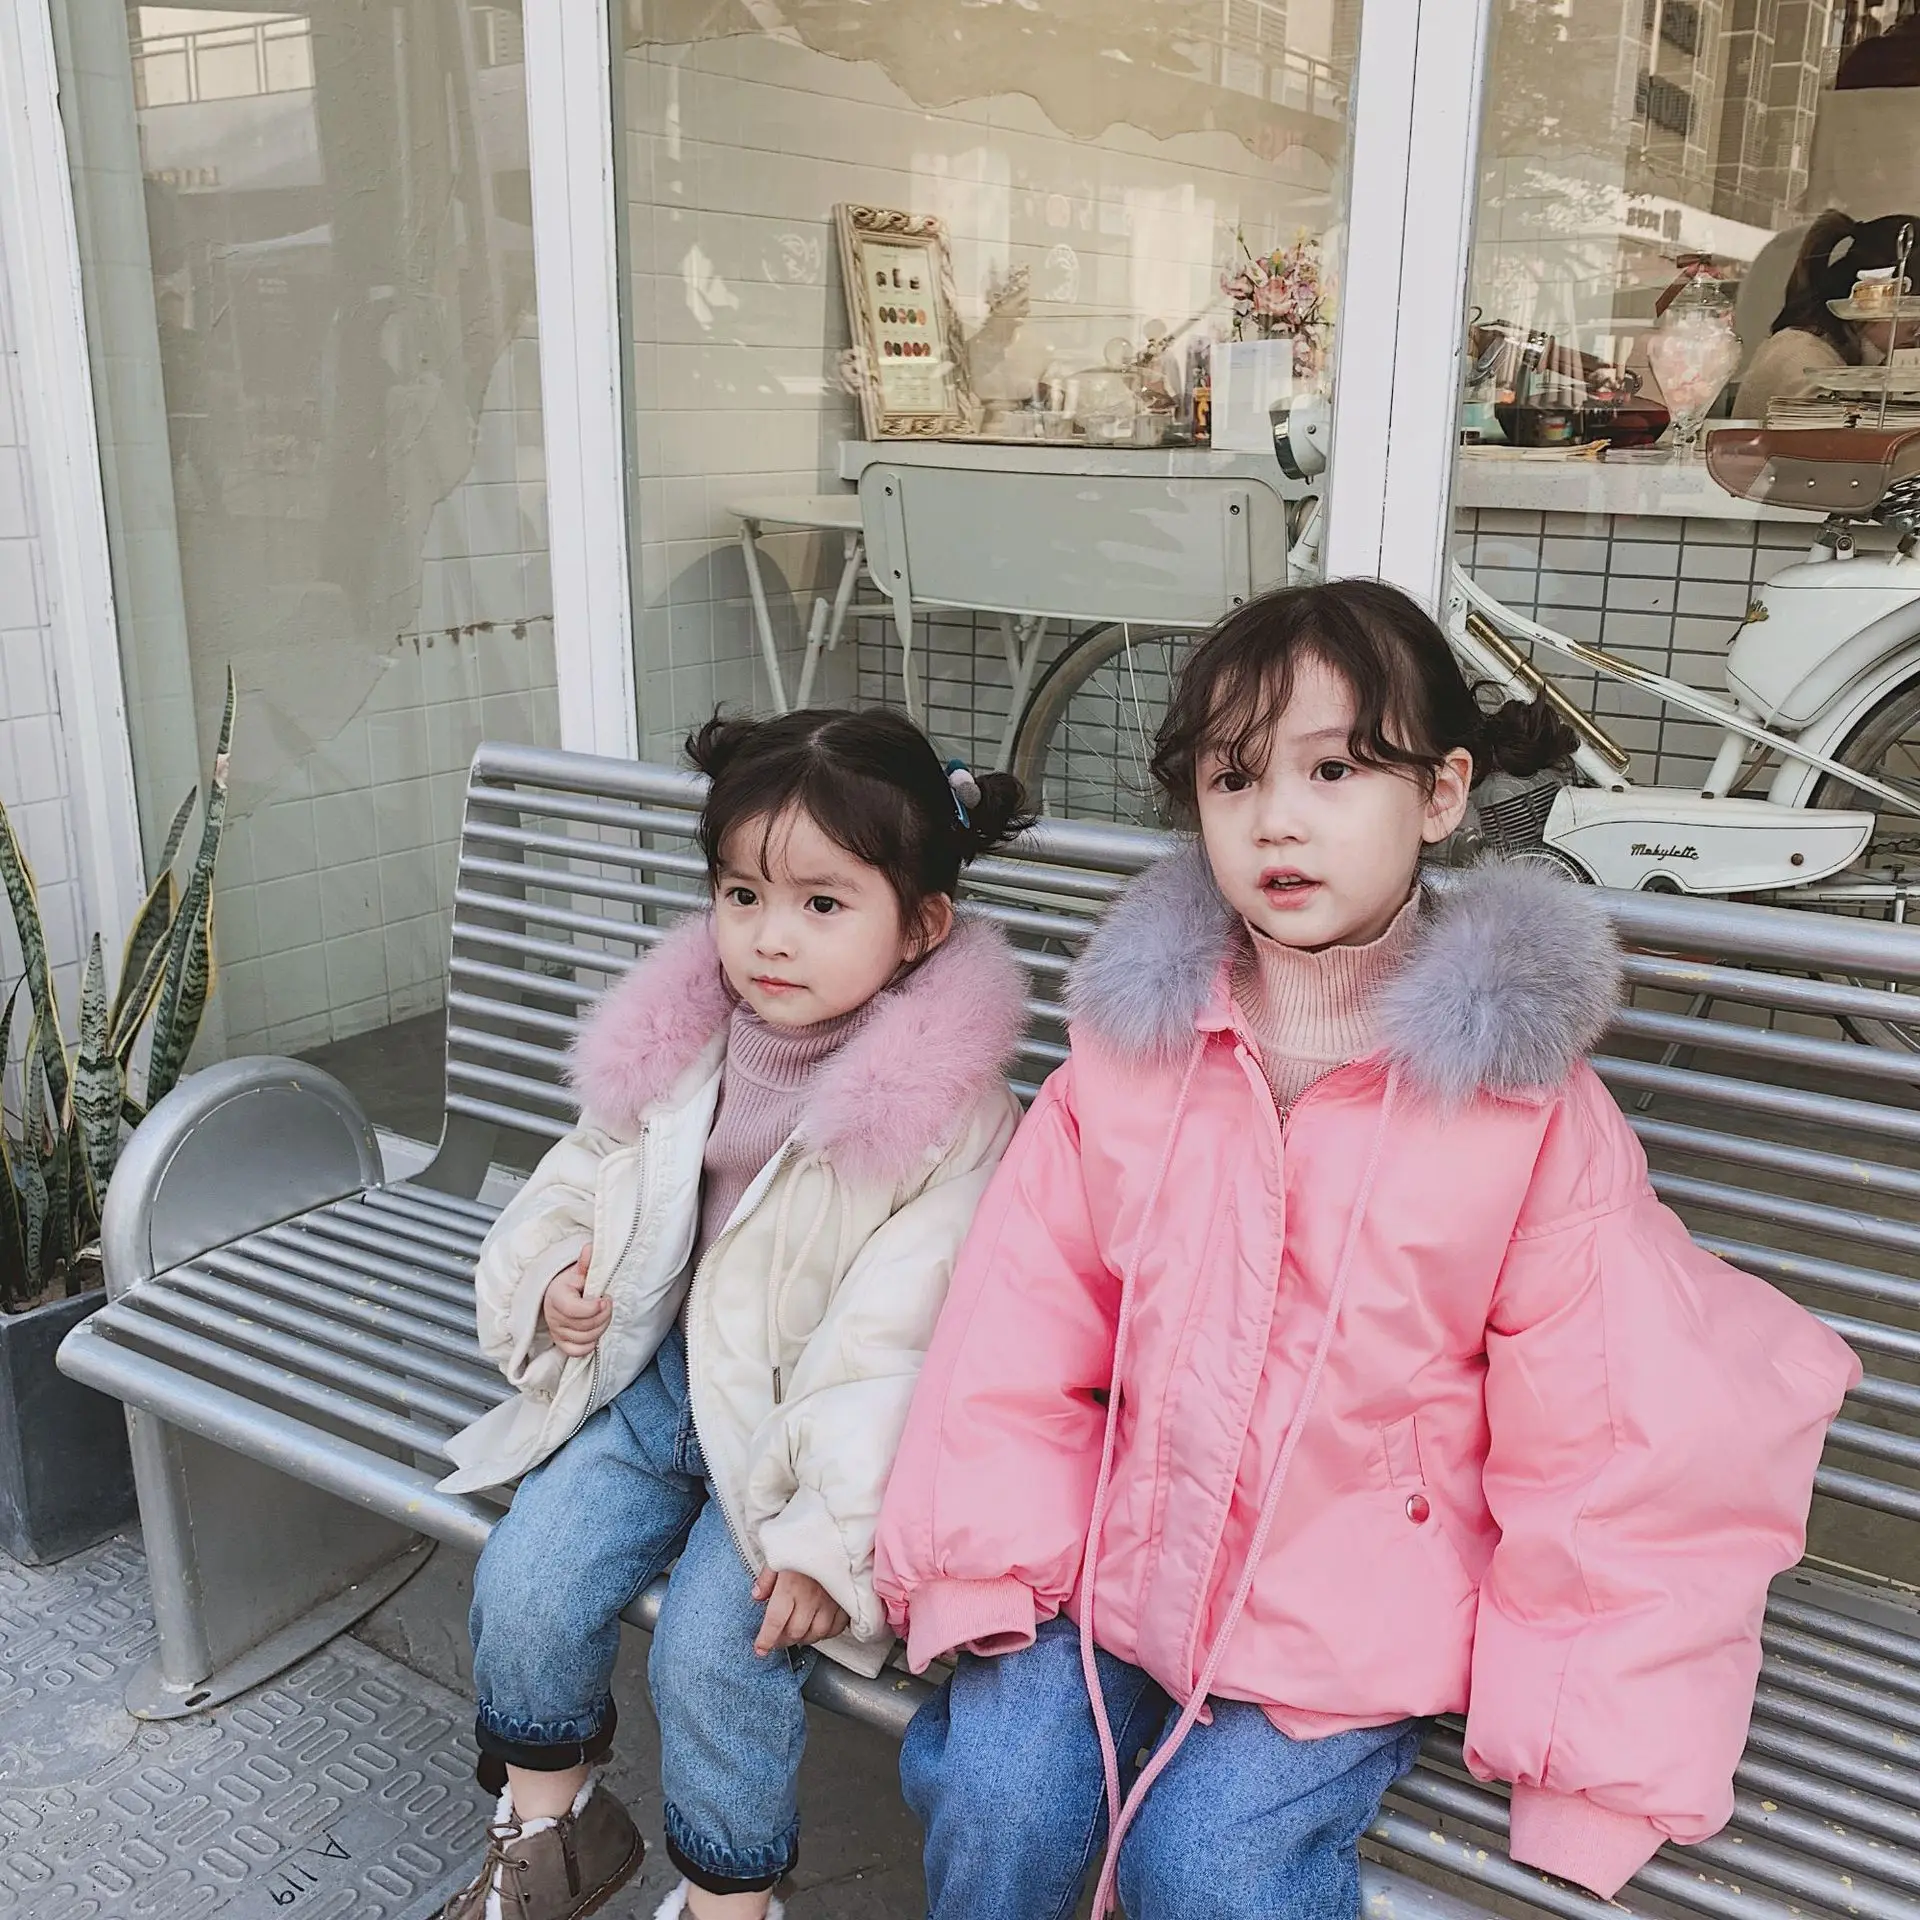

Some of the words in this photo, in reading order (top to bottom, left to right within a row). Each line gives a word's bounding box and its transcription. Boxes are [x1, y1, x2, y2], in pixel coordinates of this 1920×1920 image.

[1631, 843, 1700, 861] Mobylette
[305, 1830, 352, 1860] A
[265, 1862, 318, 1906] 119
